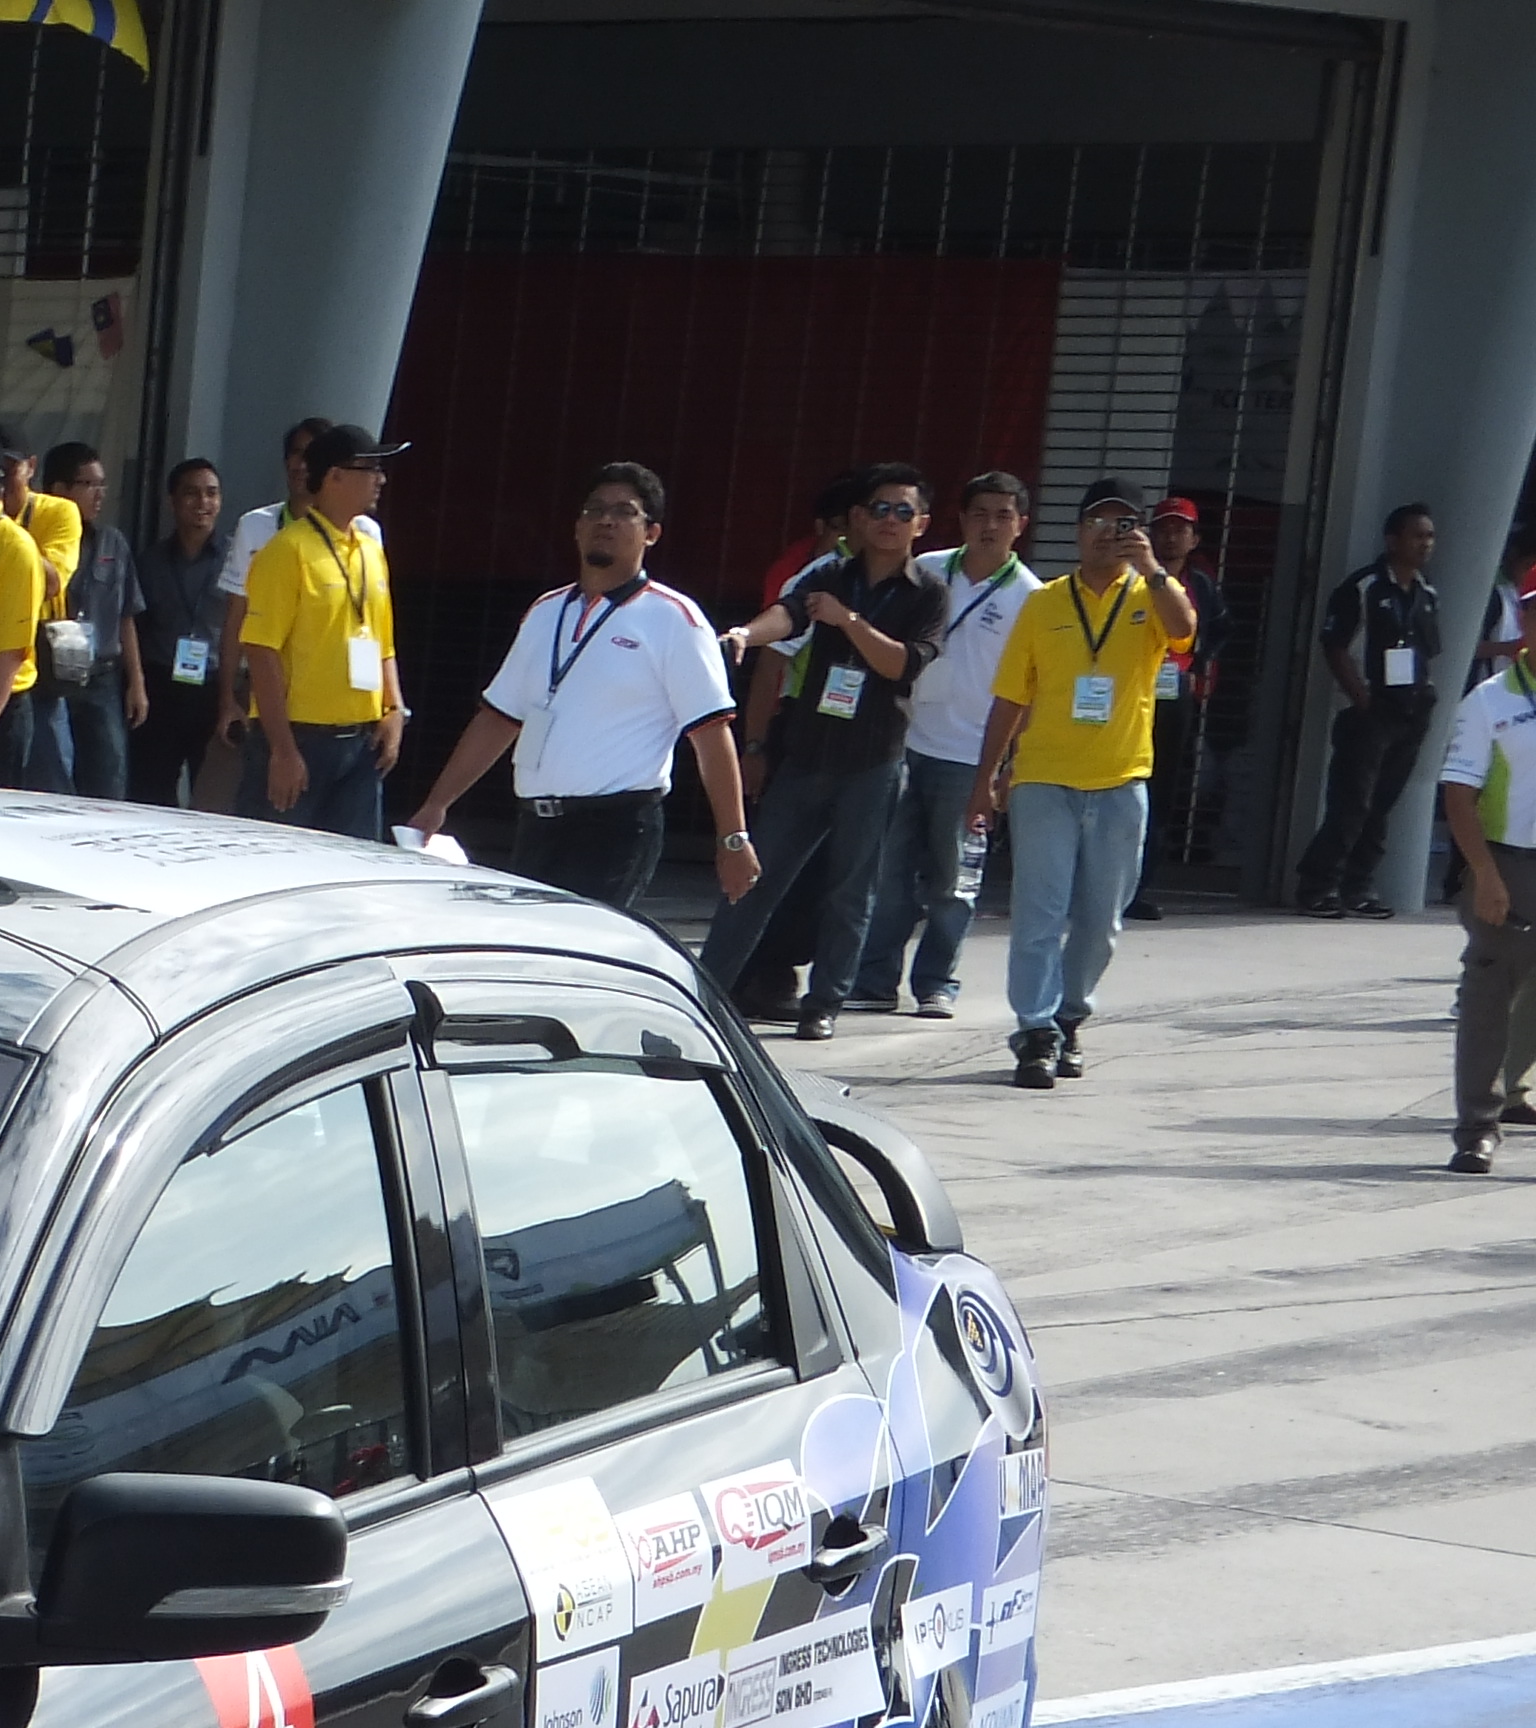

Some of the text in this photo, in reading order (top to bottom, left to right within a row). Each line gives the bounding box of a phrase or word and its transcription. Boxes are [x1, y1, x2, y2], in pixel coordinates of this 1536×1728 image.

[755, 1486, 805, 1530] IQM
[652, 1524, 700, 1560] AHP
[577, 1603, 613, 1628] NCAP
